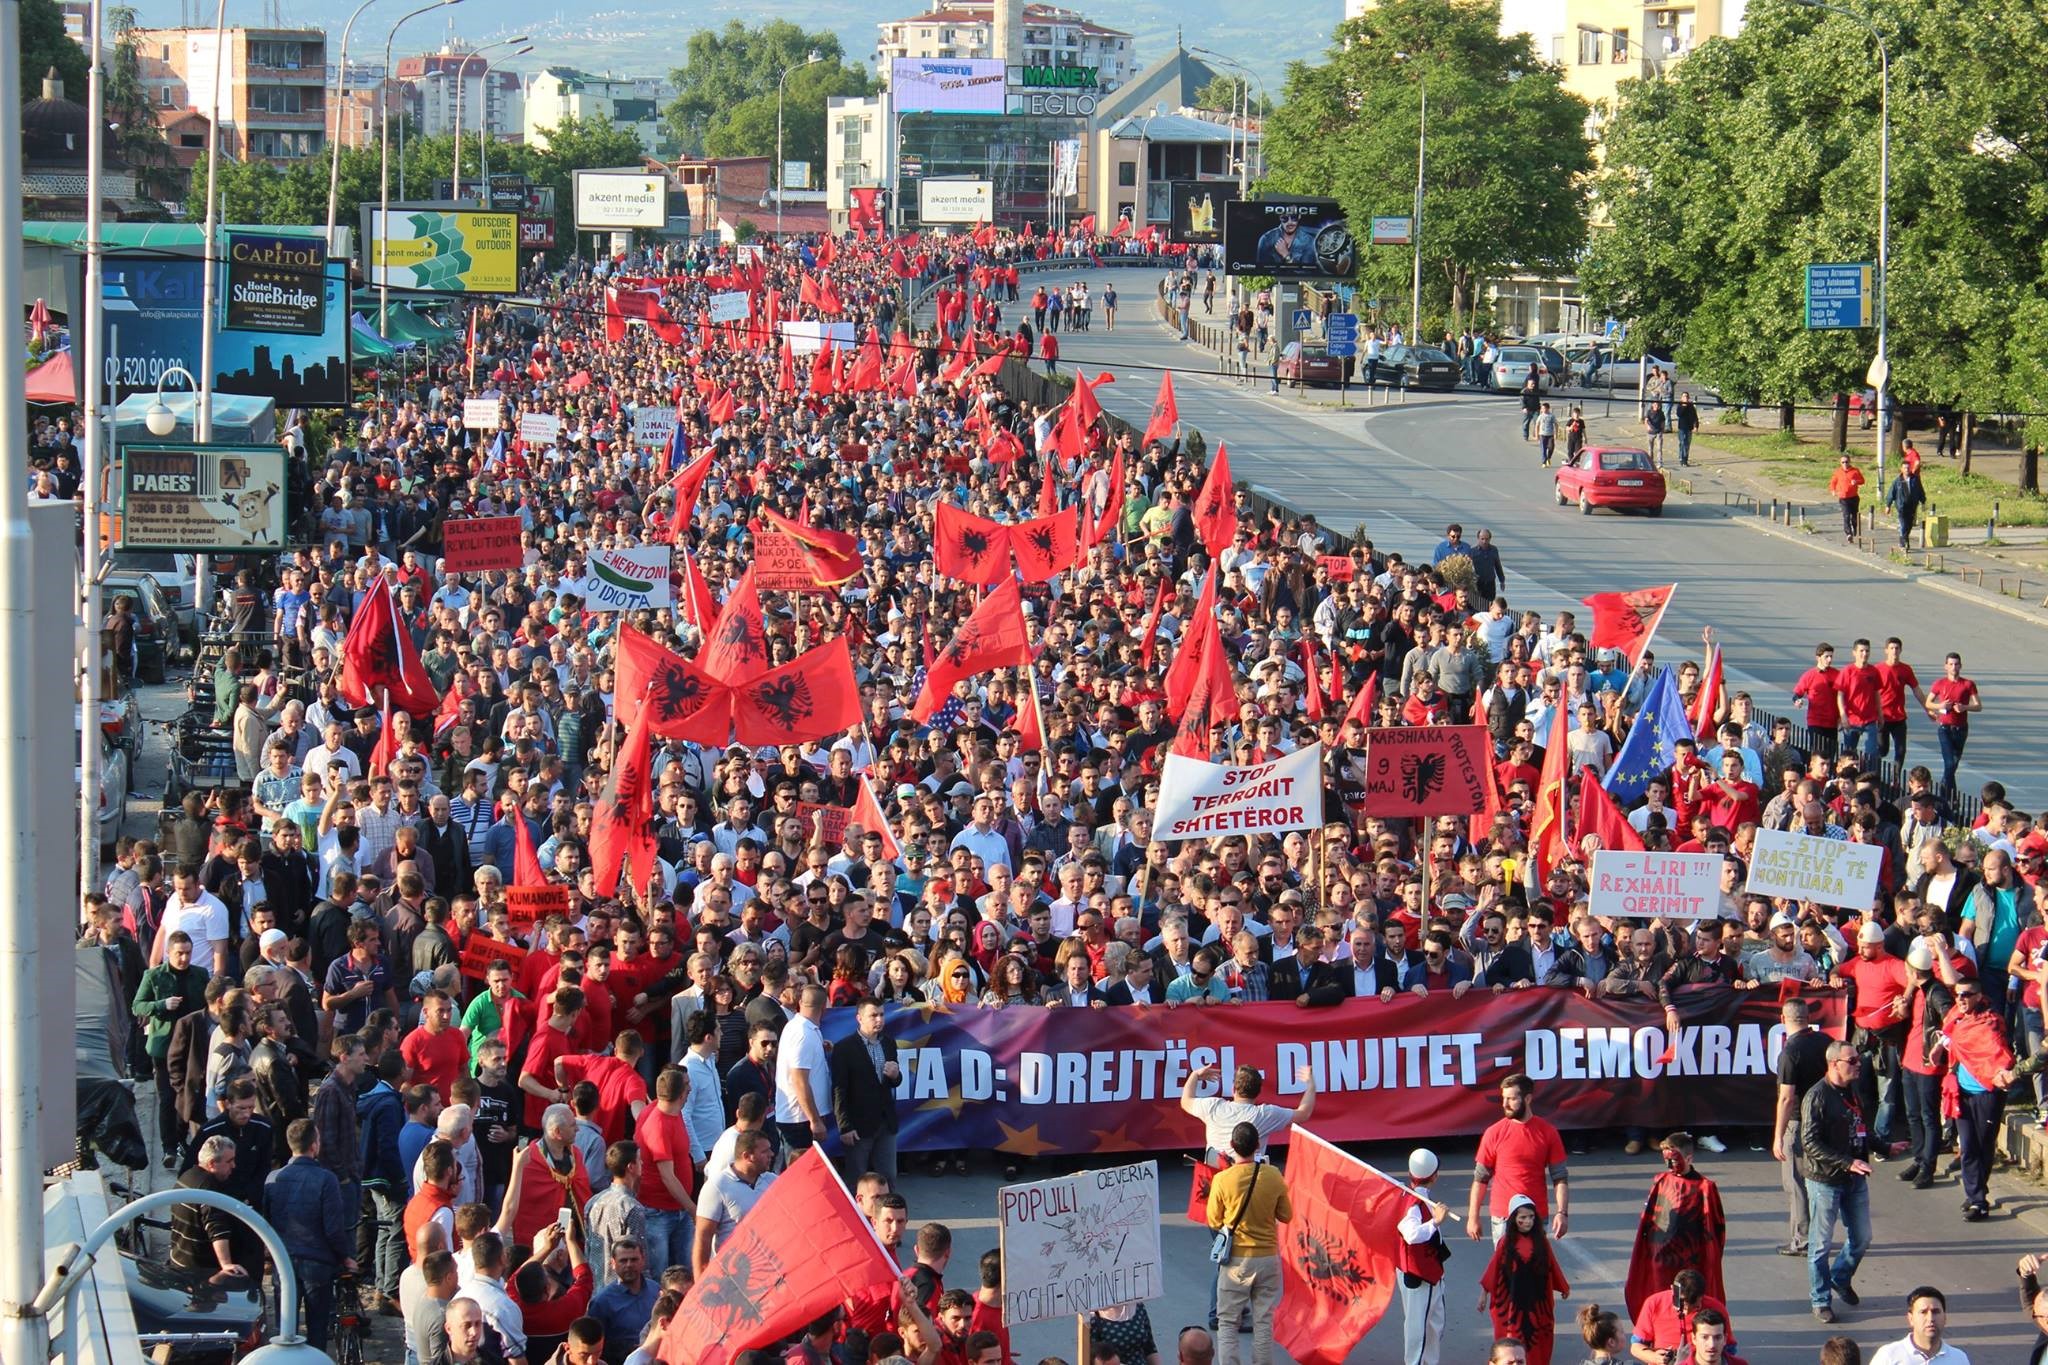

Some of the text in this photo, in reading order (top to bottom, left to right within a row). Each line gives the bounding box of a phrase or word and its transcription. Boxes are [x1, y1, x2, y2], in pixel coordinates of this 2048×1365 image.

[1024, 66, 1099, 88] MANEX
[1031, 95, 1096, 115] EGLO
[589, 193, 656, 203] akzent media
[930, 196, 986, 204] akzent media
[1265, 206, 1319, 215] POLICE
[472, 217, 512, 228] OUTSCORE
[491, 228, 512, 239] WITH
[376, 248, 432, 257] azent media
[476, 240, 512, 250] OUTDOOR
[247, 281, 272, 291] Hotel
[233, 284, 317, 309] StoneBridge
[105, 357, 120, 386] 02
[123, 357, 146, 386] 520
[150, 357, 164, 385] 90
[642, 421, 671, 430] ISMAIL
[160, 503, 173, 514] 58
[176, 503, 190, 514] 28
[448, 523, 486, 535] BLACK
[496, 519, 518, 530] RED
[757, 548, 774, 557] NUK
[603, 550, 668, 579] E MERITONI
[587, 578, 651, 609] O IDIOTA
[1370, 730, 1444, 744] KARSHIAKA
[1223, 764, 1276, 785] STOP
[1377, 758, 1390, 775] 9
[1448, 732, 1486, 812] PROTESTON
[1192, 777, 1294, 811] TERRORIT
[1368, 780, 1395, 793] MAJ
[1172, 806, 1305, 834] SHTETËROR
[1643, 856, 1686, 876] LIRI
[1757, 848, 1868, 880] RASTEVE TË
[1600, 873, 1685, 896] REXHAIL
[1754, 866, 1844, 896] MONTUARA
[1622, 896, 1704, 914] QERIMIT
[960, 1048, 1006, 1102] D:
[1020, 1038, 1235, 1105] DREJTËSI
[1276, 1033, 1482, 1095] DINJITET
[1525, 1023, 1819, 1081] DEMOKRAC
[1097, 1165, 1154, 1190] QEVERIA
